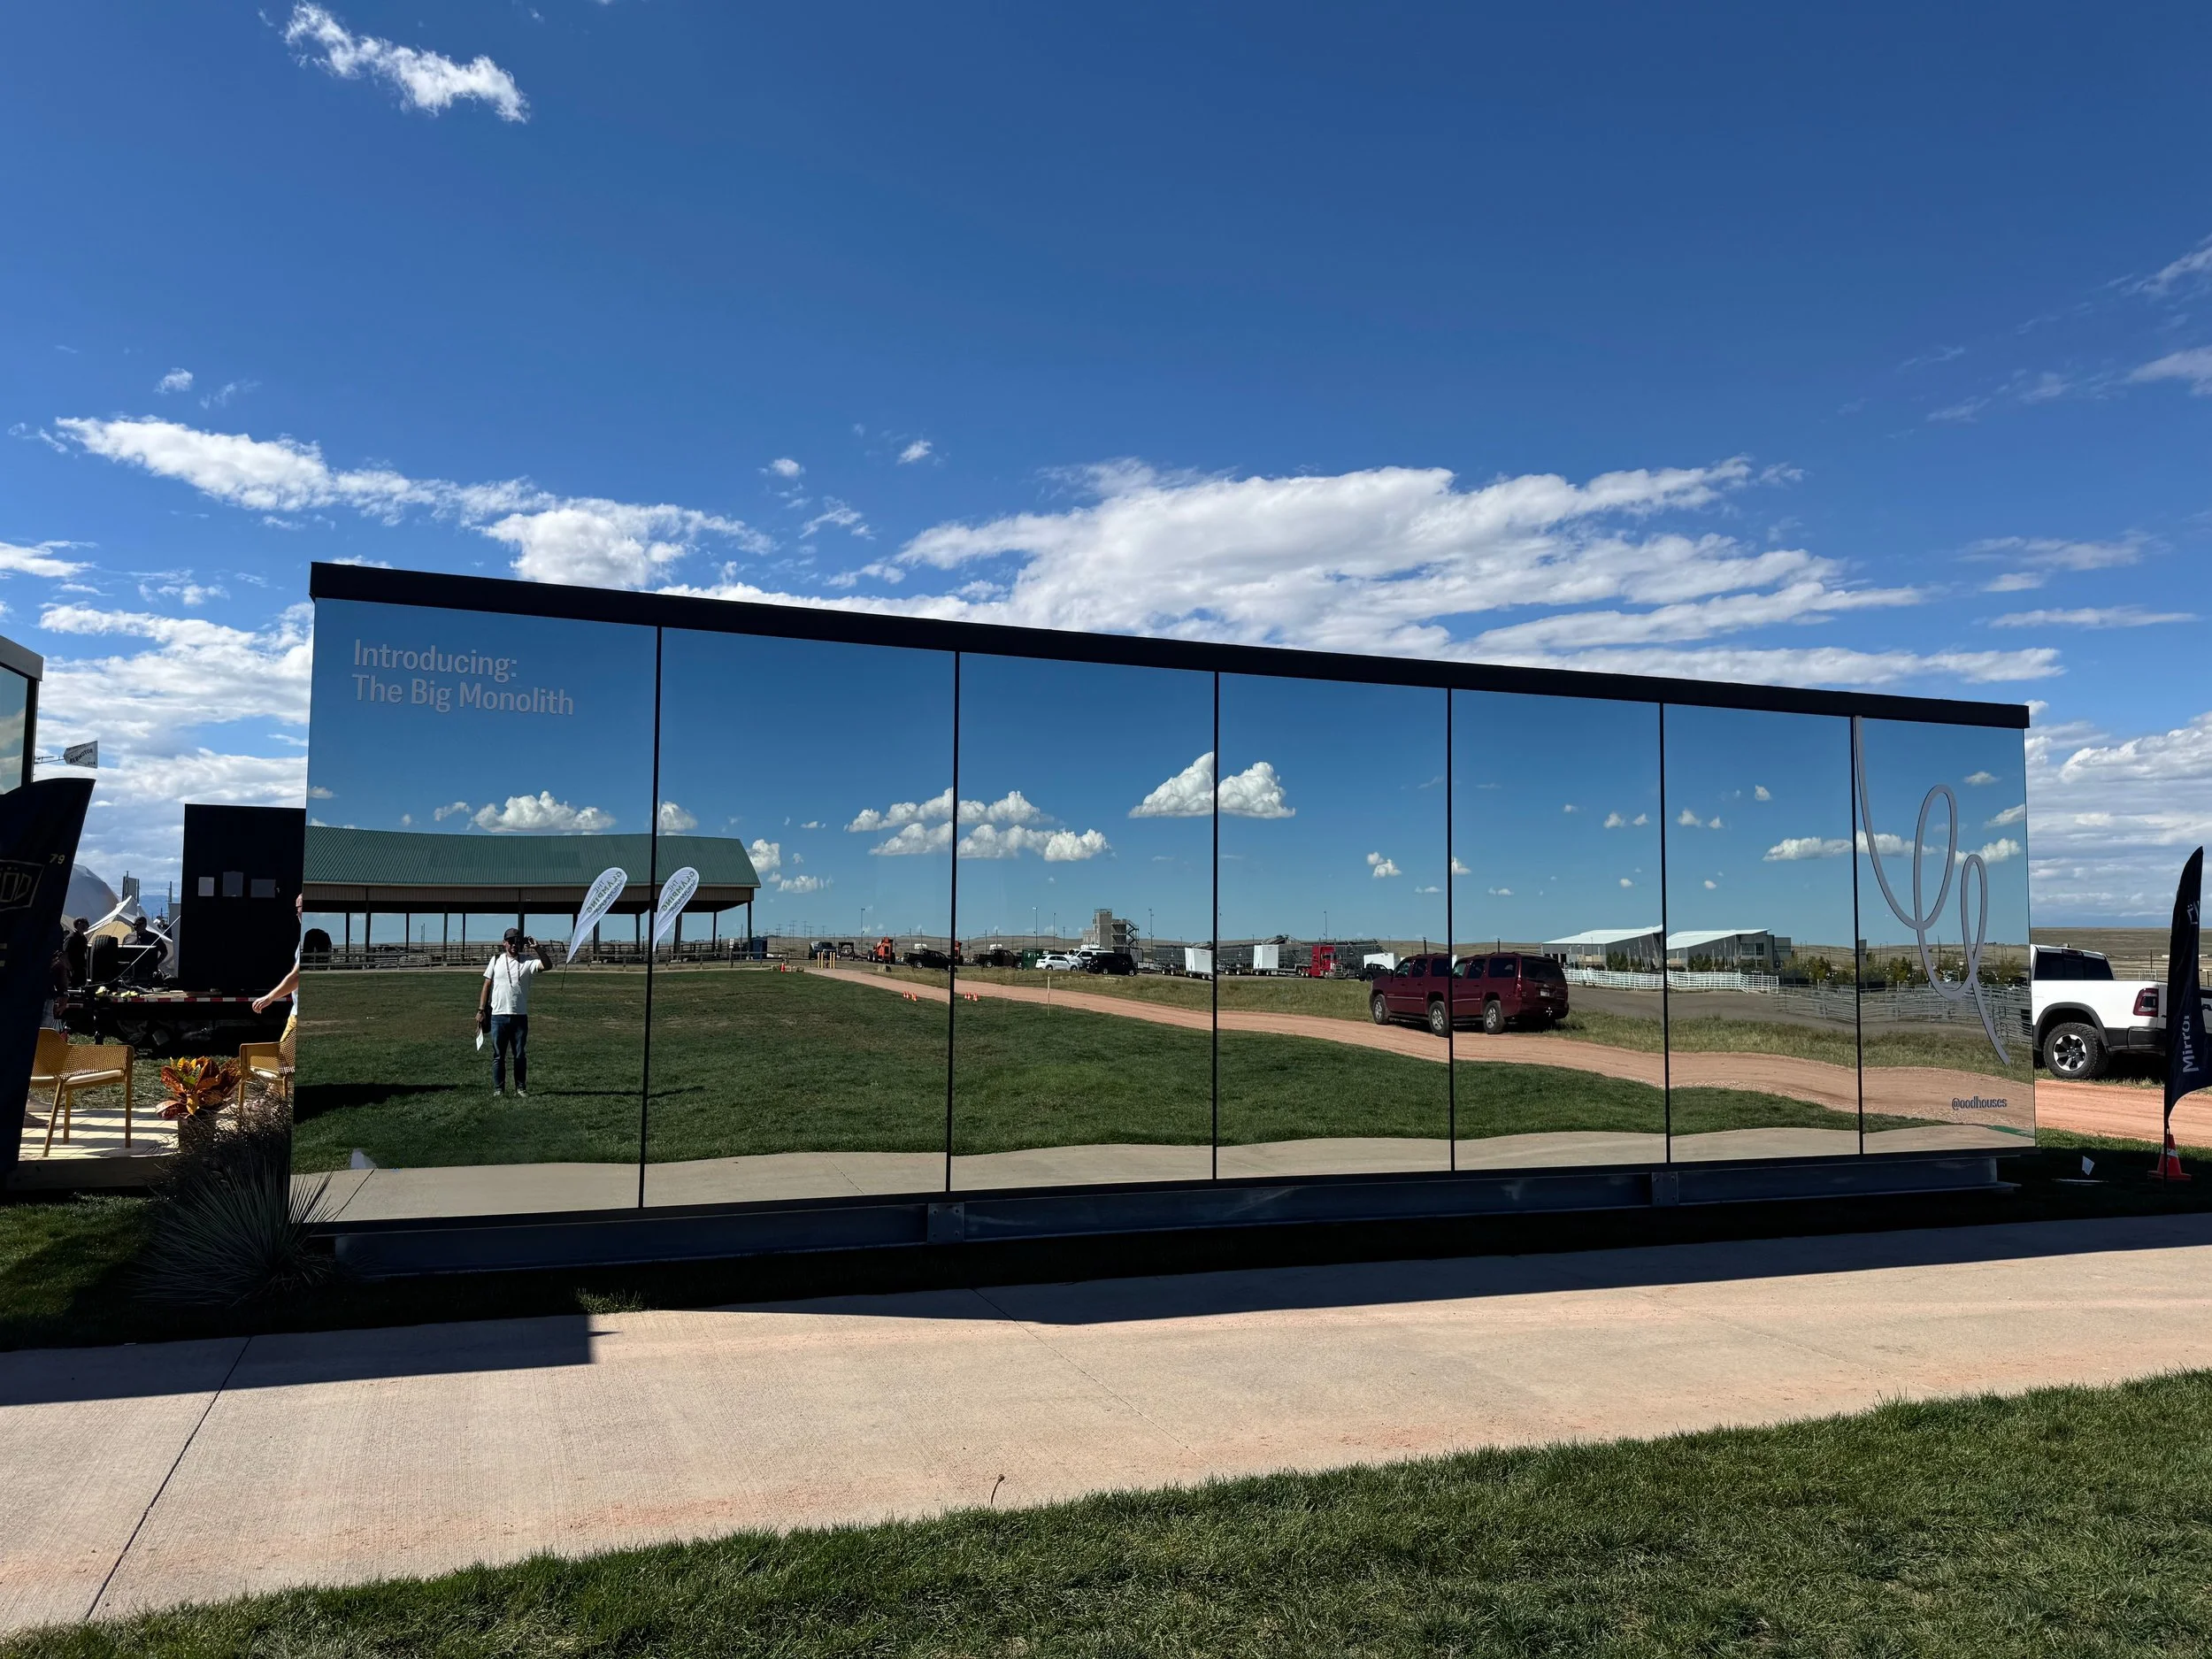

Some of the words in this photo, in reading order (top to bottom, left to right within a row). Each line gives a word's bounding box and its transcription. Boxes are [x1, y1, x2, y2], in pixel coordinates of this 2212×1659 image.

[354, 638, 518, 683] Introducing:
[351, 673, 403, 703] The
[411, 677, 452, 713] Big
[459, 681, 574, 716] Monolith
[1951, 1095, 2008, 1110] @oodhouses
